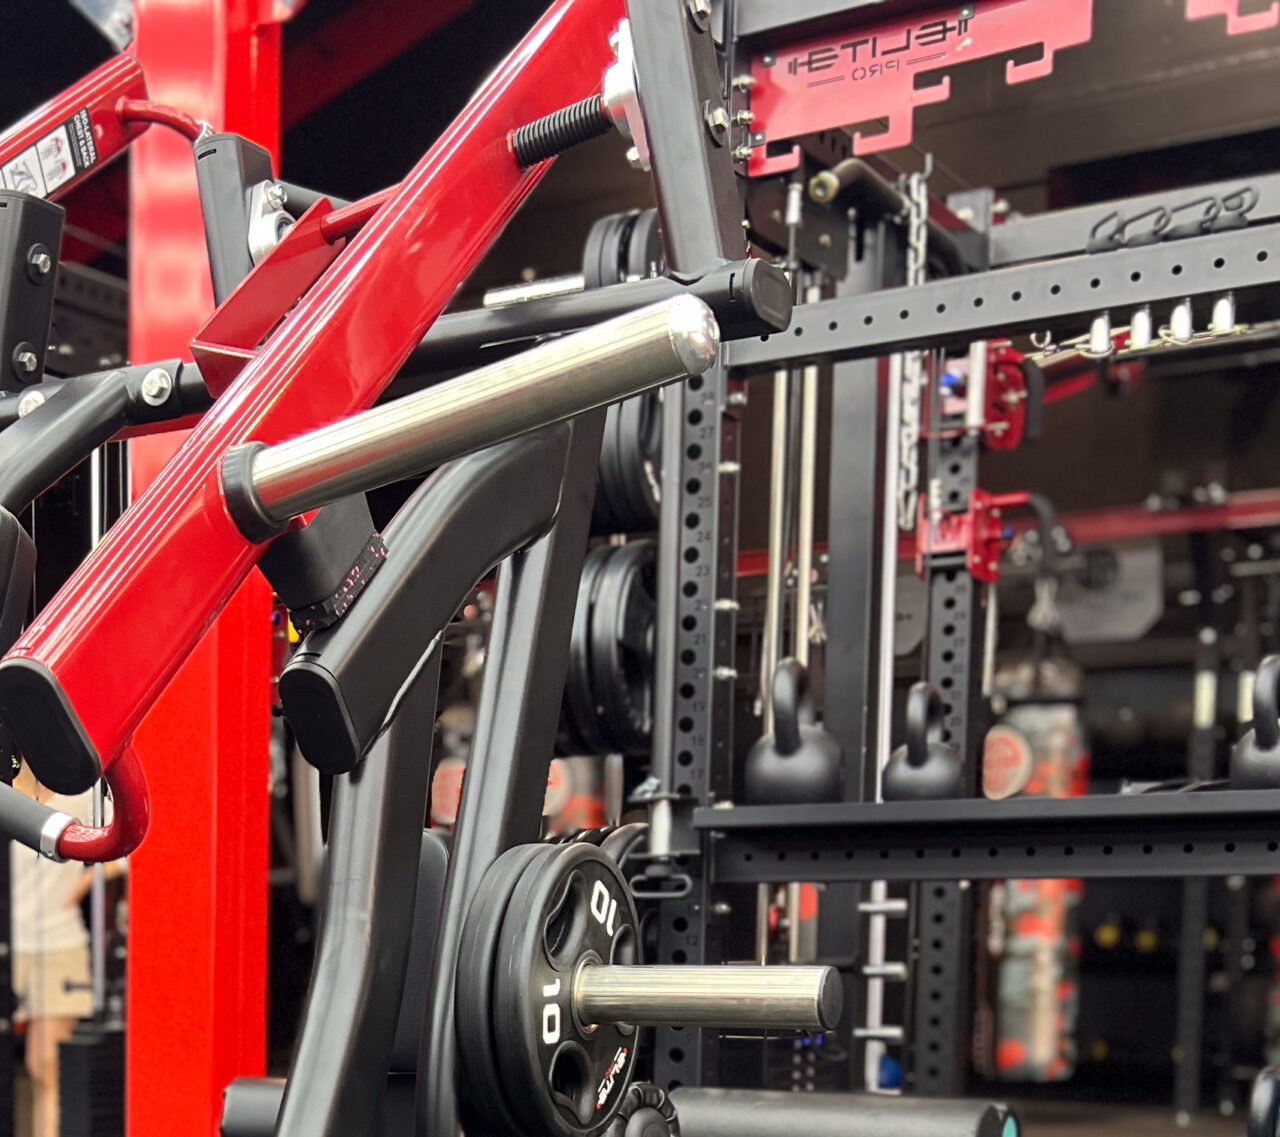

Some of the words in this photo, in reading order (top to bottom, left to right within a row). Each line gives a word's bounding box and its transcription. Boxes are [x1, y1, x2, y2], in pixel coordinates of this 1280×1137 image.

[74, 114, 85, 139] CHEST
[81, 146, 91, 168] BACK
[80, 109, 96, 164] ISO-LATERAL
[697, 531, 711, 543] 24
[696, 565, 710, 577] 23
[591, 879, 617, 937] 10
[542, 978, 561, 1044] 10
